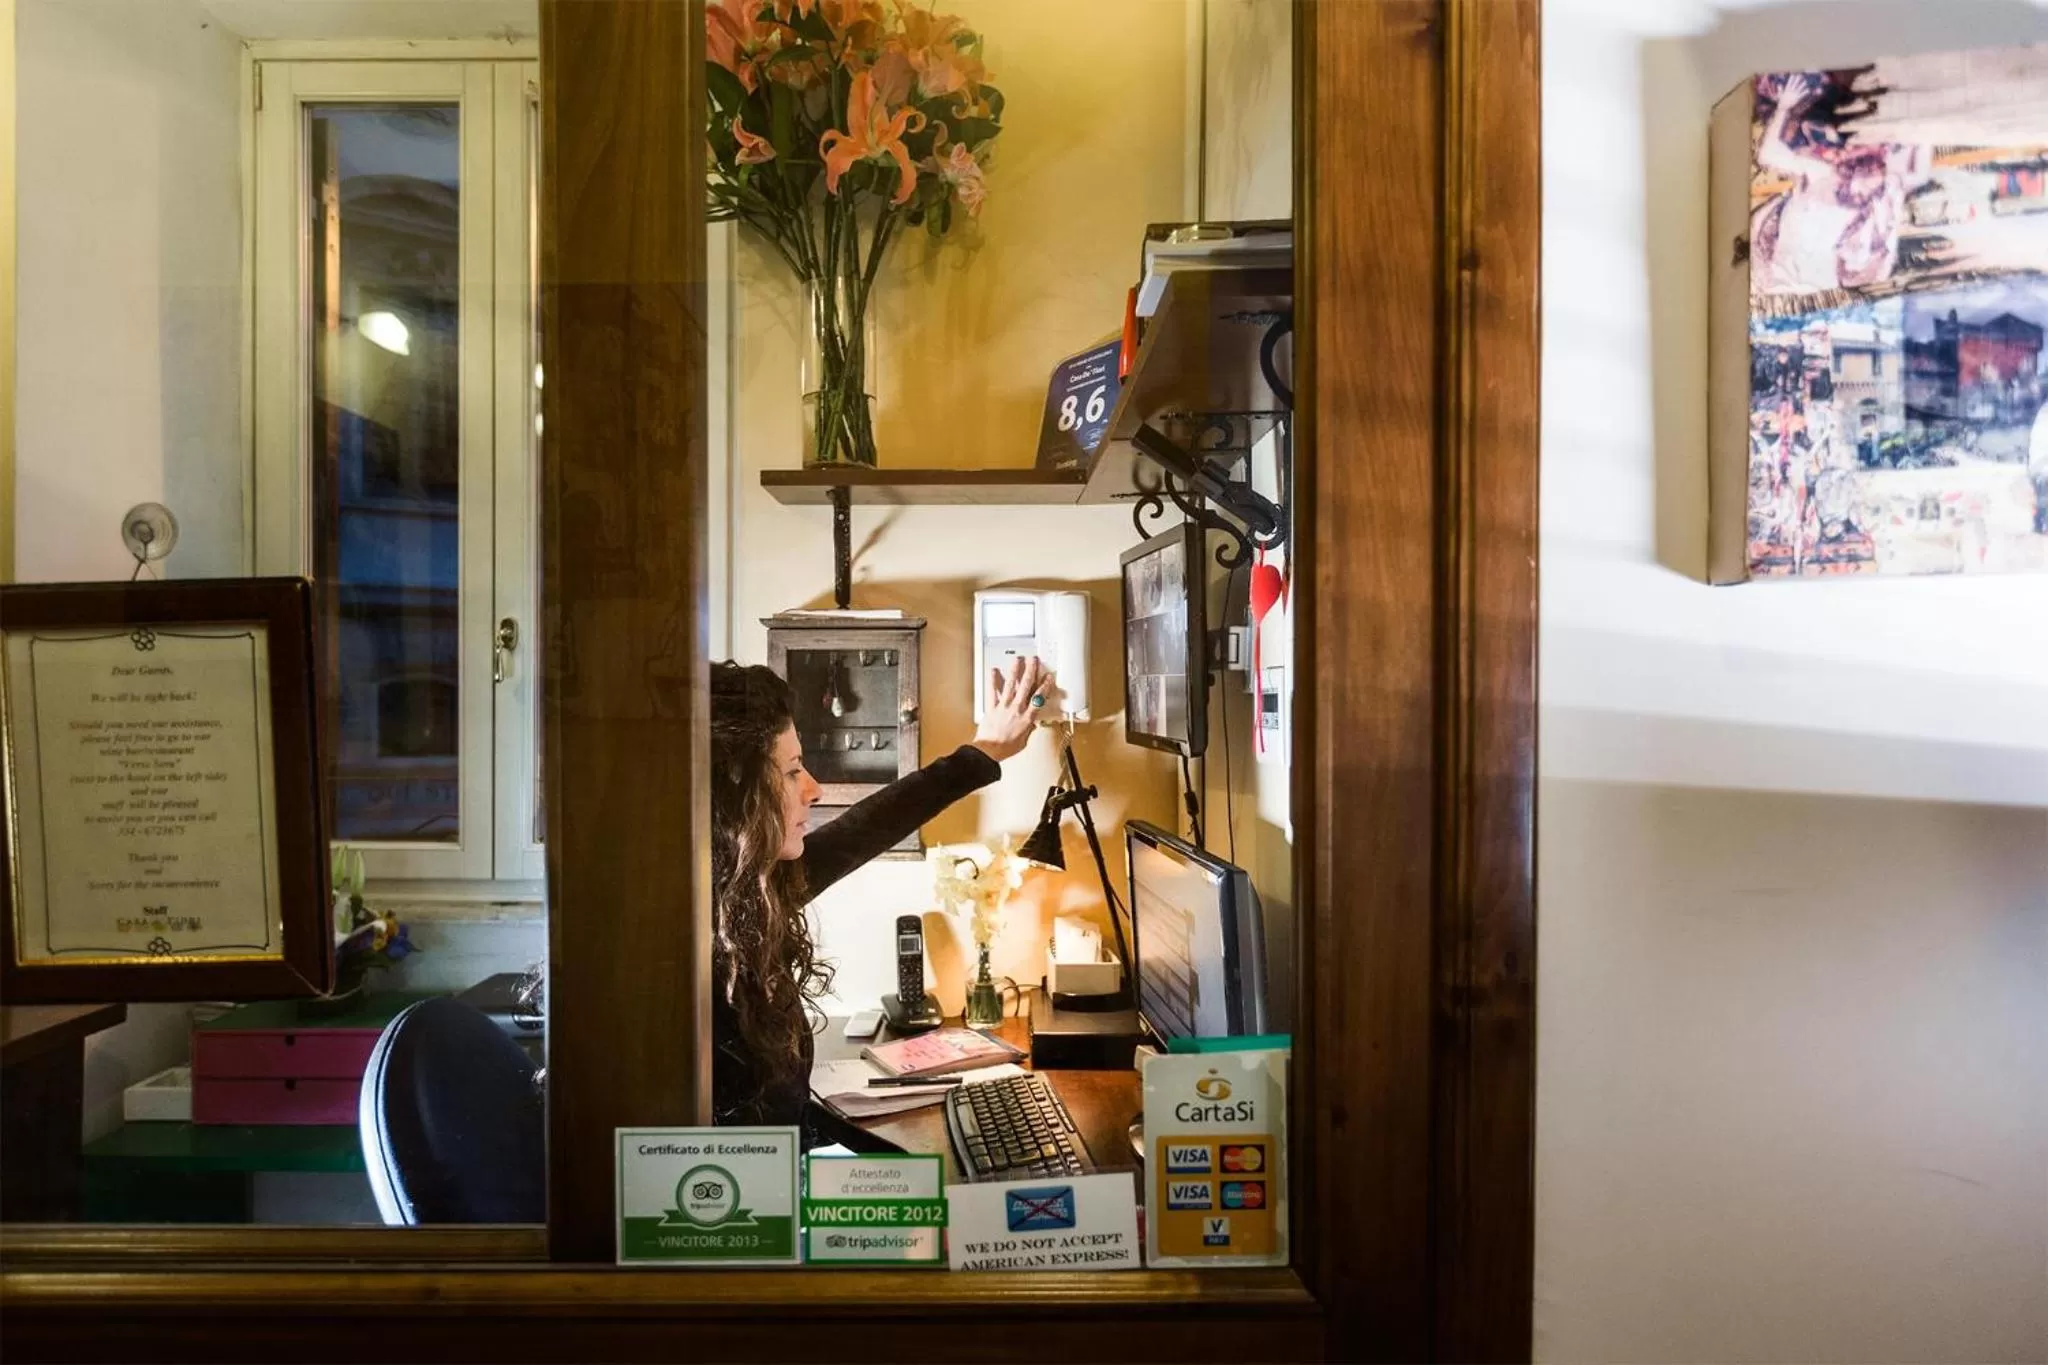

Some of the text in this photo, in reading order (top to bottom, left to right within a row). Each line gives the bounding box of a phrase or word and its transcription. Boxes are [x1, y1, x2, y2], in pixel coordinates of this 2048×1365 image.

[1058, 384, 1107, 432] 8,6
[1175, 1101, 1254, 1123] CartaSi
[638, 1143, 778, 1156] Certificato di Eccellenza
[1172, 1148, 1209, 1163] VISA
[850, 1168, 901, 1180] Attestato
[841, 1182, 910, 1194] d'eccellenza
[1173, 1185, 1209, 1199] VISA
[807, 1205, 943, 1221] VINCITORE 2012
[1211, 1219, 1223, 1233] V
[658, 1235, 760, 1248] VINCITORE 2013
[848, 1235, 920, 1250] tripadvisor
[965, 1233, 1123, 1254] WE DO NOT ACCEPT
[961, 1249, 1130, 1272] AMERICAN EXPRESS!
